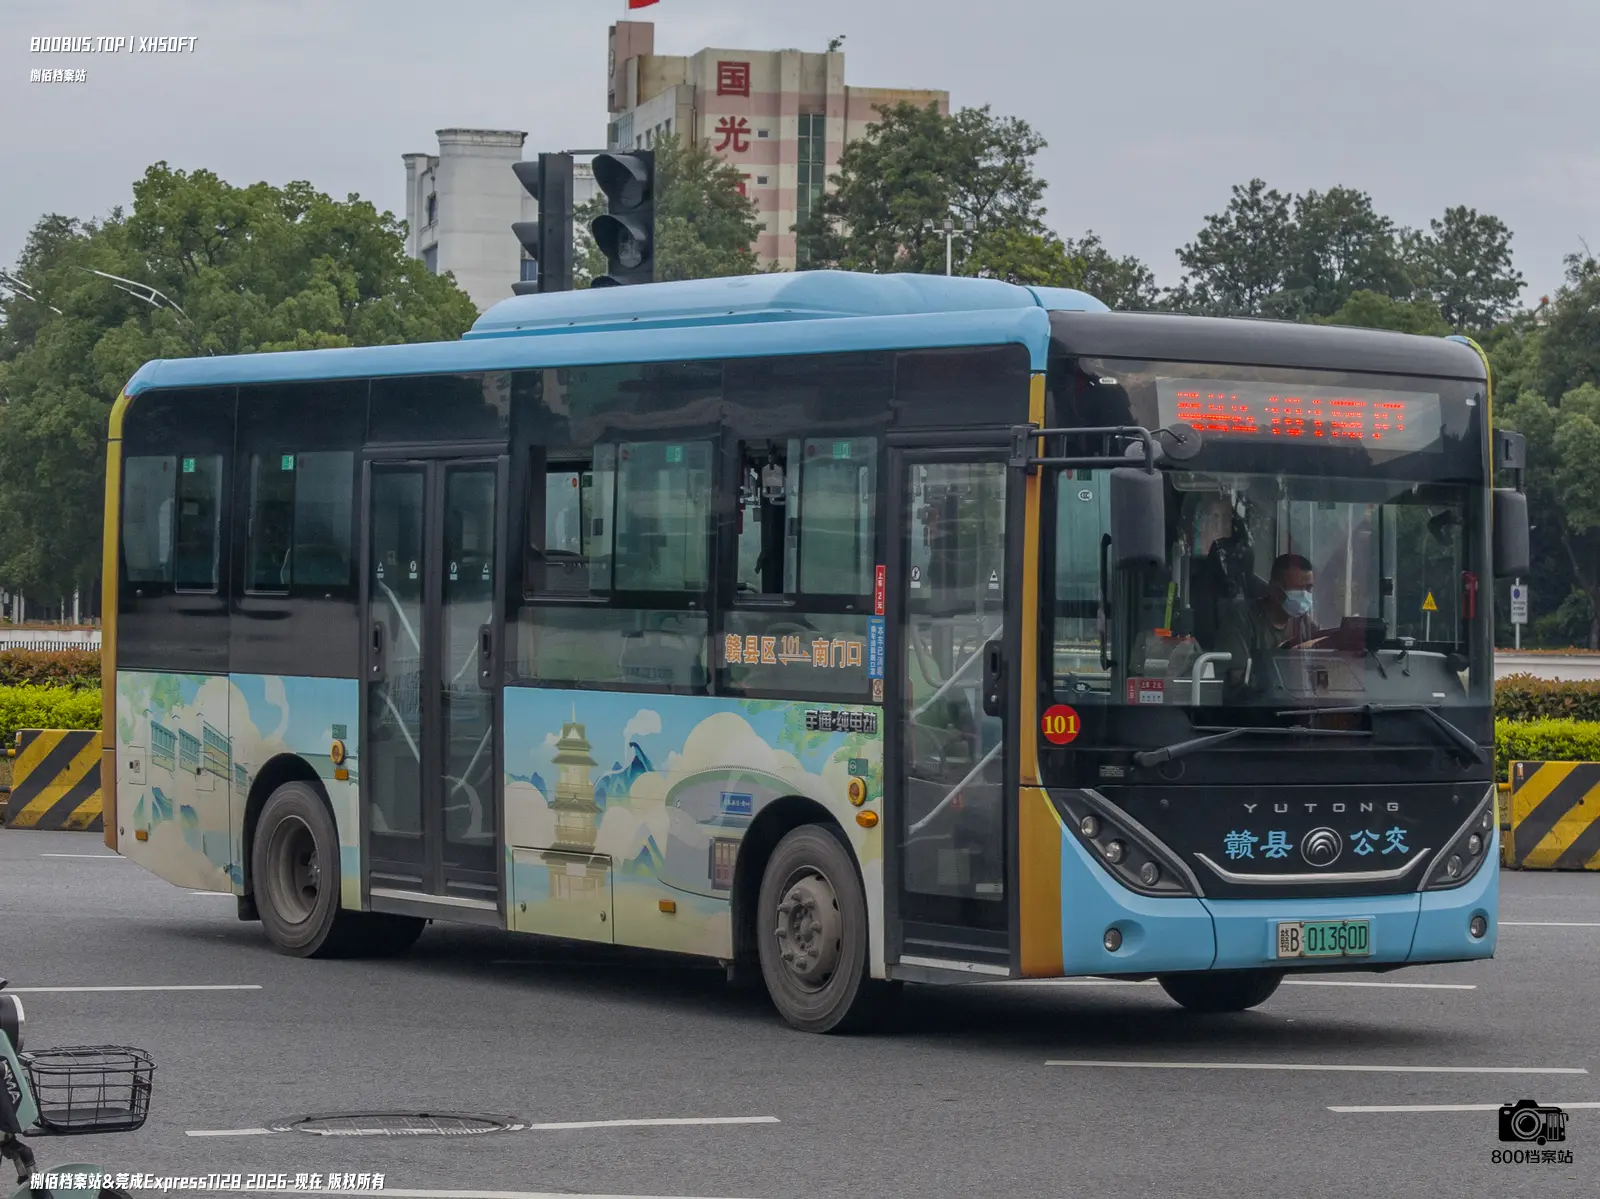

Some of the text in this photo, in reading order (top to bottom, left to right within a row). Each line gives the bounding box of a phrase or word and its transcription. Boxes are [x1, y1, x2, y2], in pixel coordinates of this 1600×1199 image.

[725, 633, 777, 664] 赣县区
[811, 638, 862, 668] 南门口
[1044, 716, 1077, 734] 101
[1243, 802, 1399, 813] YUTONG
[1223, 826, 1410, 859] 赣县 公交
